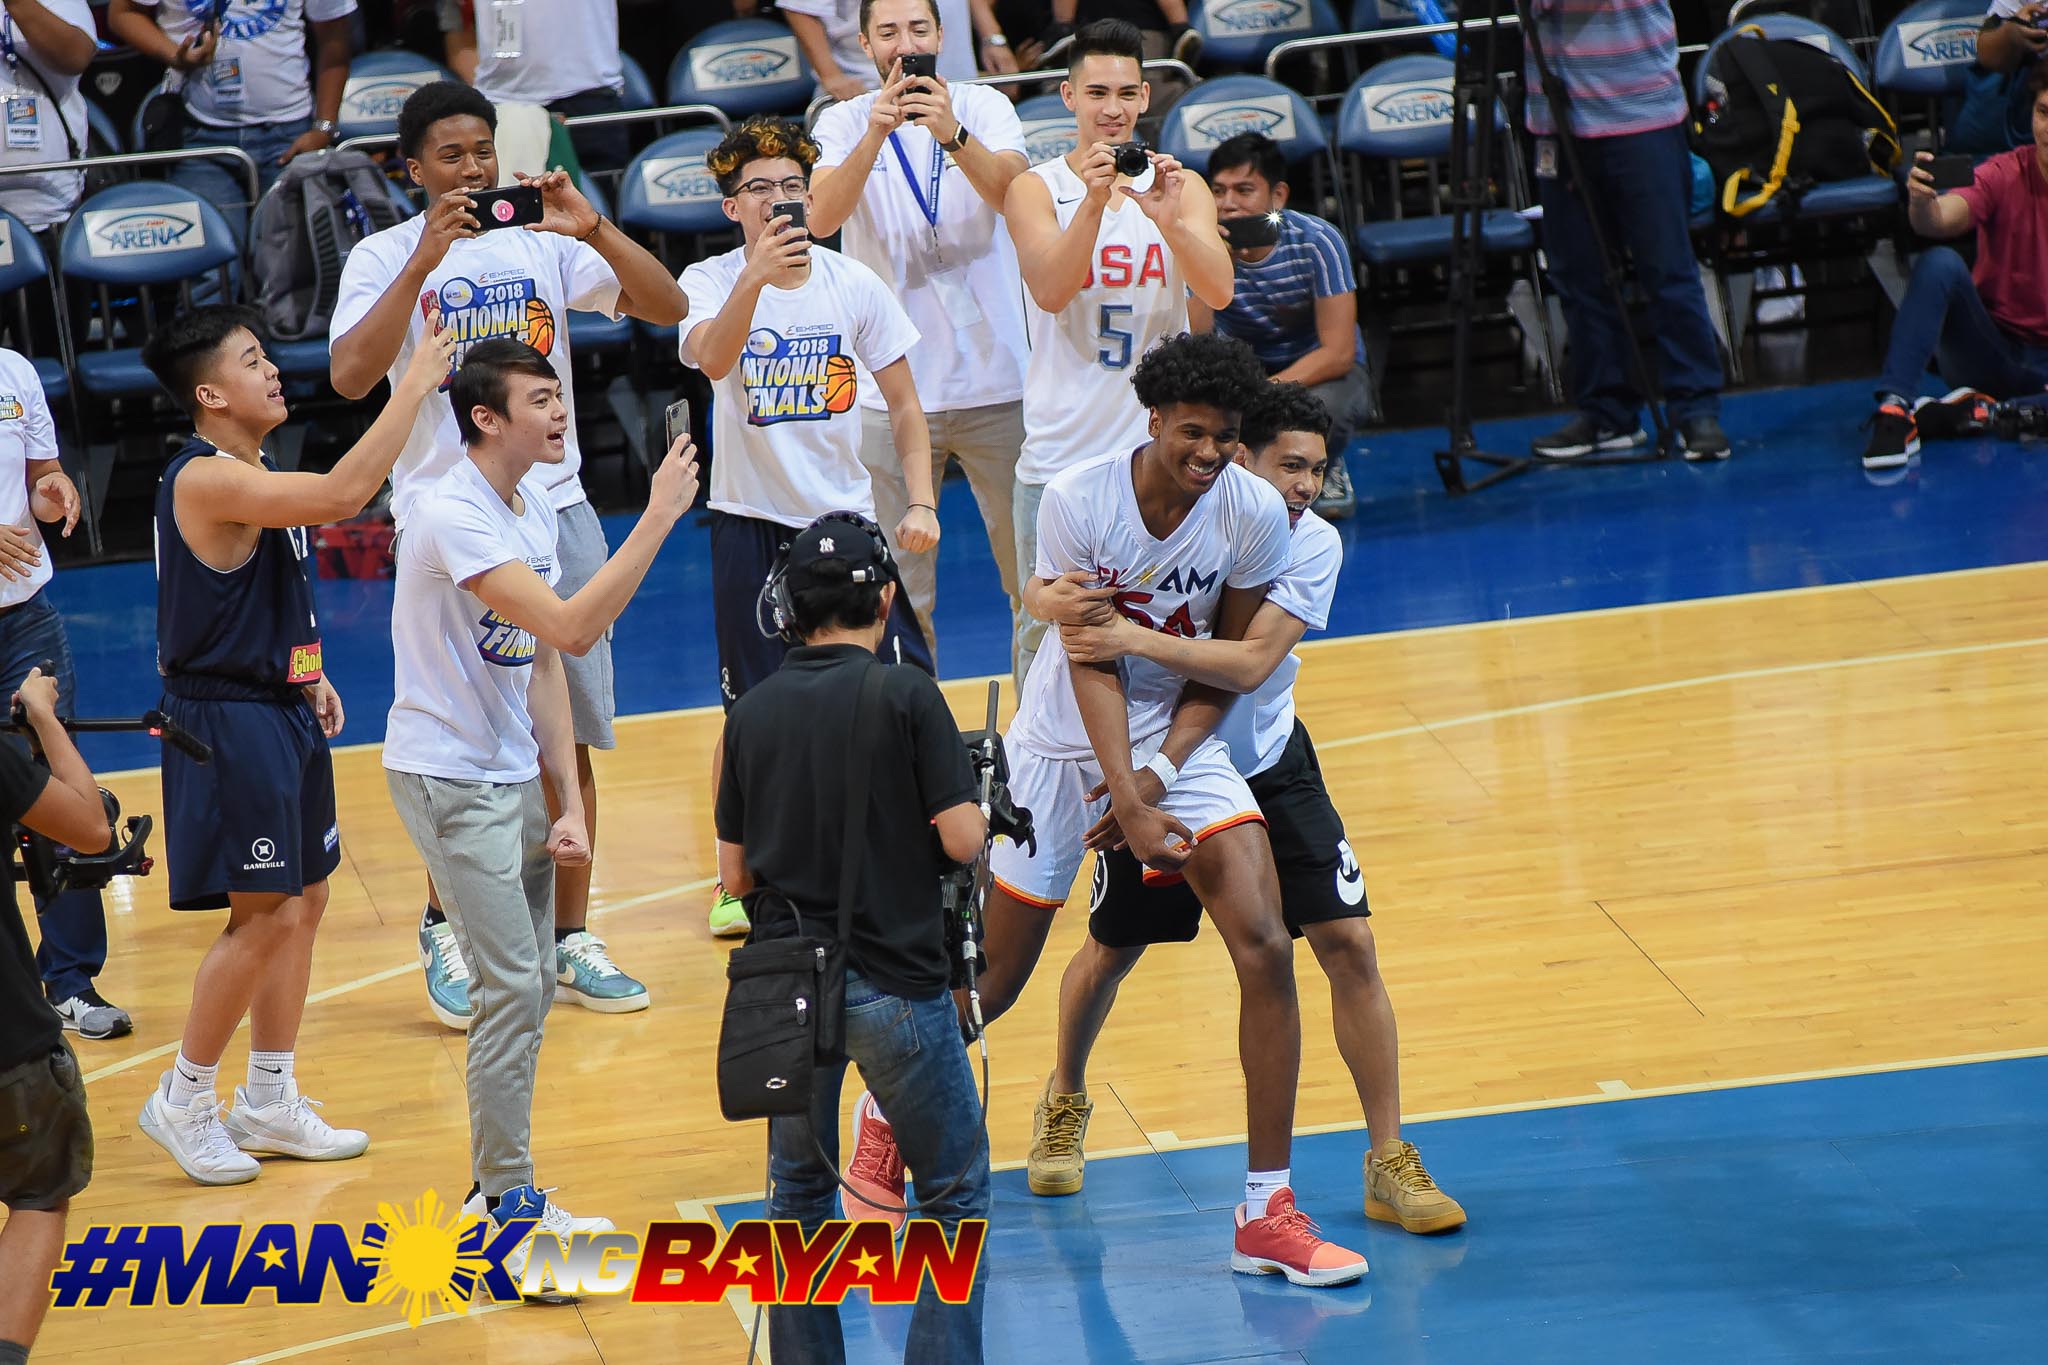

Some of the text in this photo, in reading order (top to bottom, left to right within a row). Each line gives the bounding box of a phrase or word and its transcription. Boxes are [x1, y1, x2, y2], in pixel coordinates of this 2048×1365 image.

[1922, 37, 1977, 61] AREN
[1385, 99, 1455, 123] ARENA
[666, 175, 721, 198] AREN
[111, 226, 183, 250] ARENA
[1080, 243, 1167, 288] SA
[484, 283, 524, 305] 2018
[440, 299, 529, 342] ATIONAL
[787, 338, 829, 356] 2018
[1098, 303, 1133, 370] 5
[748, 385, 828, 417] FINALS
[1156, 565, 1219, 596] AM
[243, 860, 286, 871] GAMEVILLE
